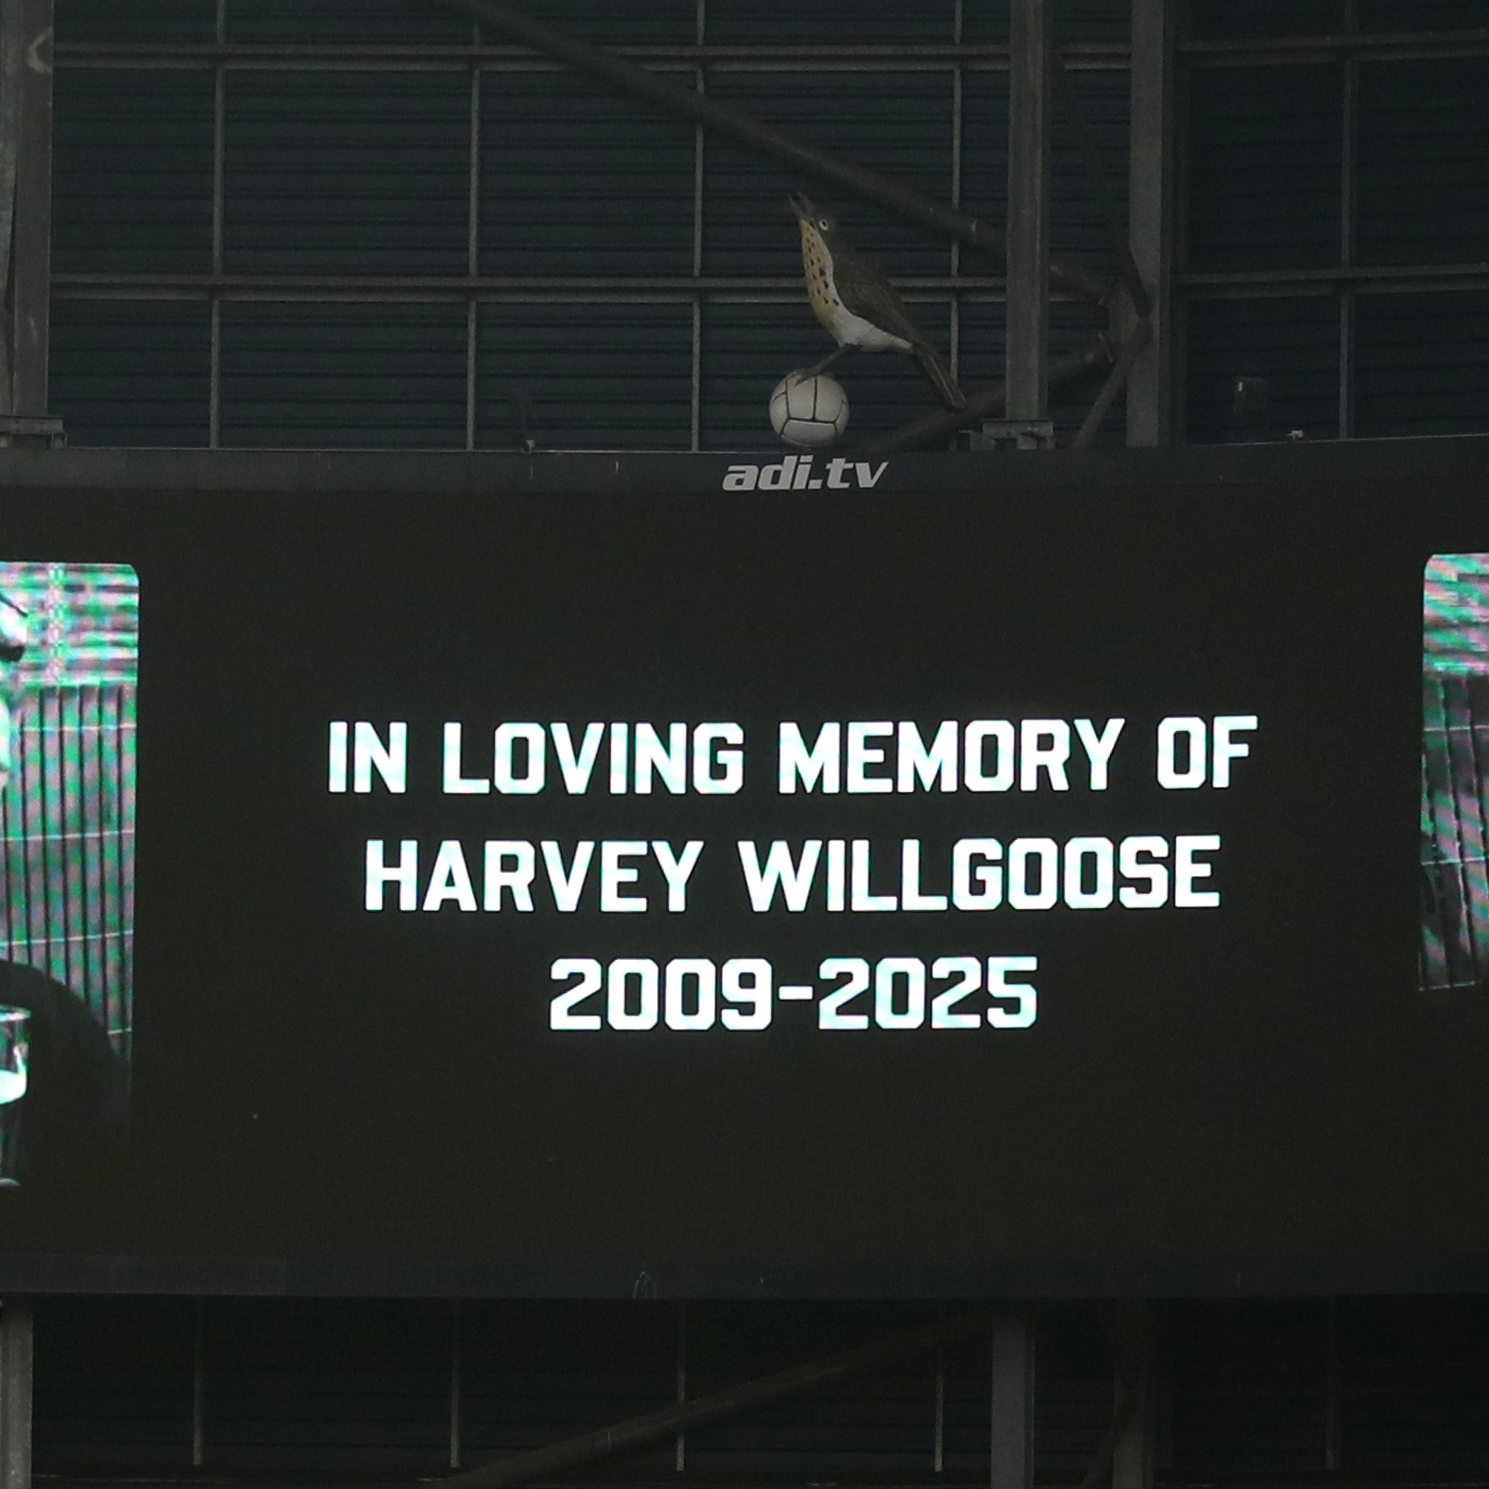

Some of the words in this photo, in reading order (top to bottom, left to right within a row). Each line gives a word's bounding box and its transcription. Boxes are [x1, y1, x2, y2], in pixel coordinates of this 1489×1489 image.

[722, 455, 889, 491] adi.tv
[329, 722, 407, 793] IN
[443, 723, 743, 794] LOVING
[779, 718, 1125, 793] MEMORY
[1158, 716, 1257, 789] OF
[366, 840, 704, 912] HARVEY
[738, 835, 1220, 911] WILLGOOSE
[551, 957, 1037, 1030] 2009-2025
